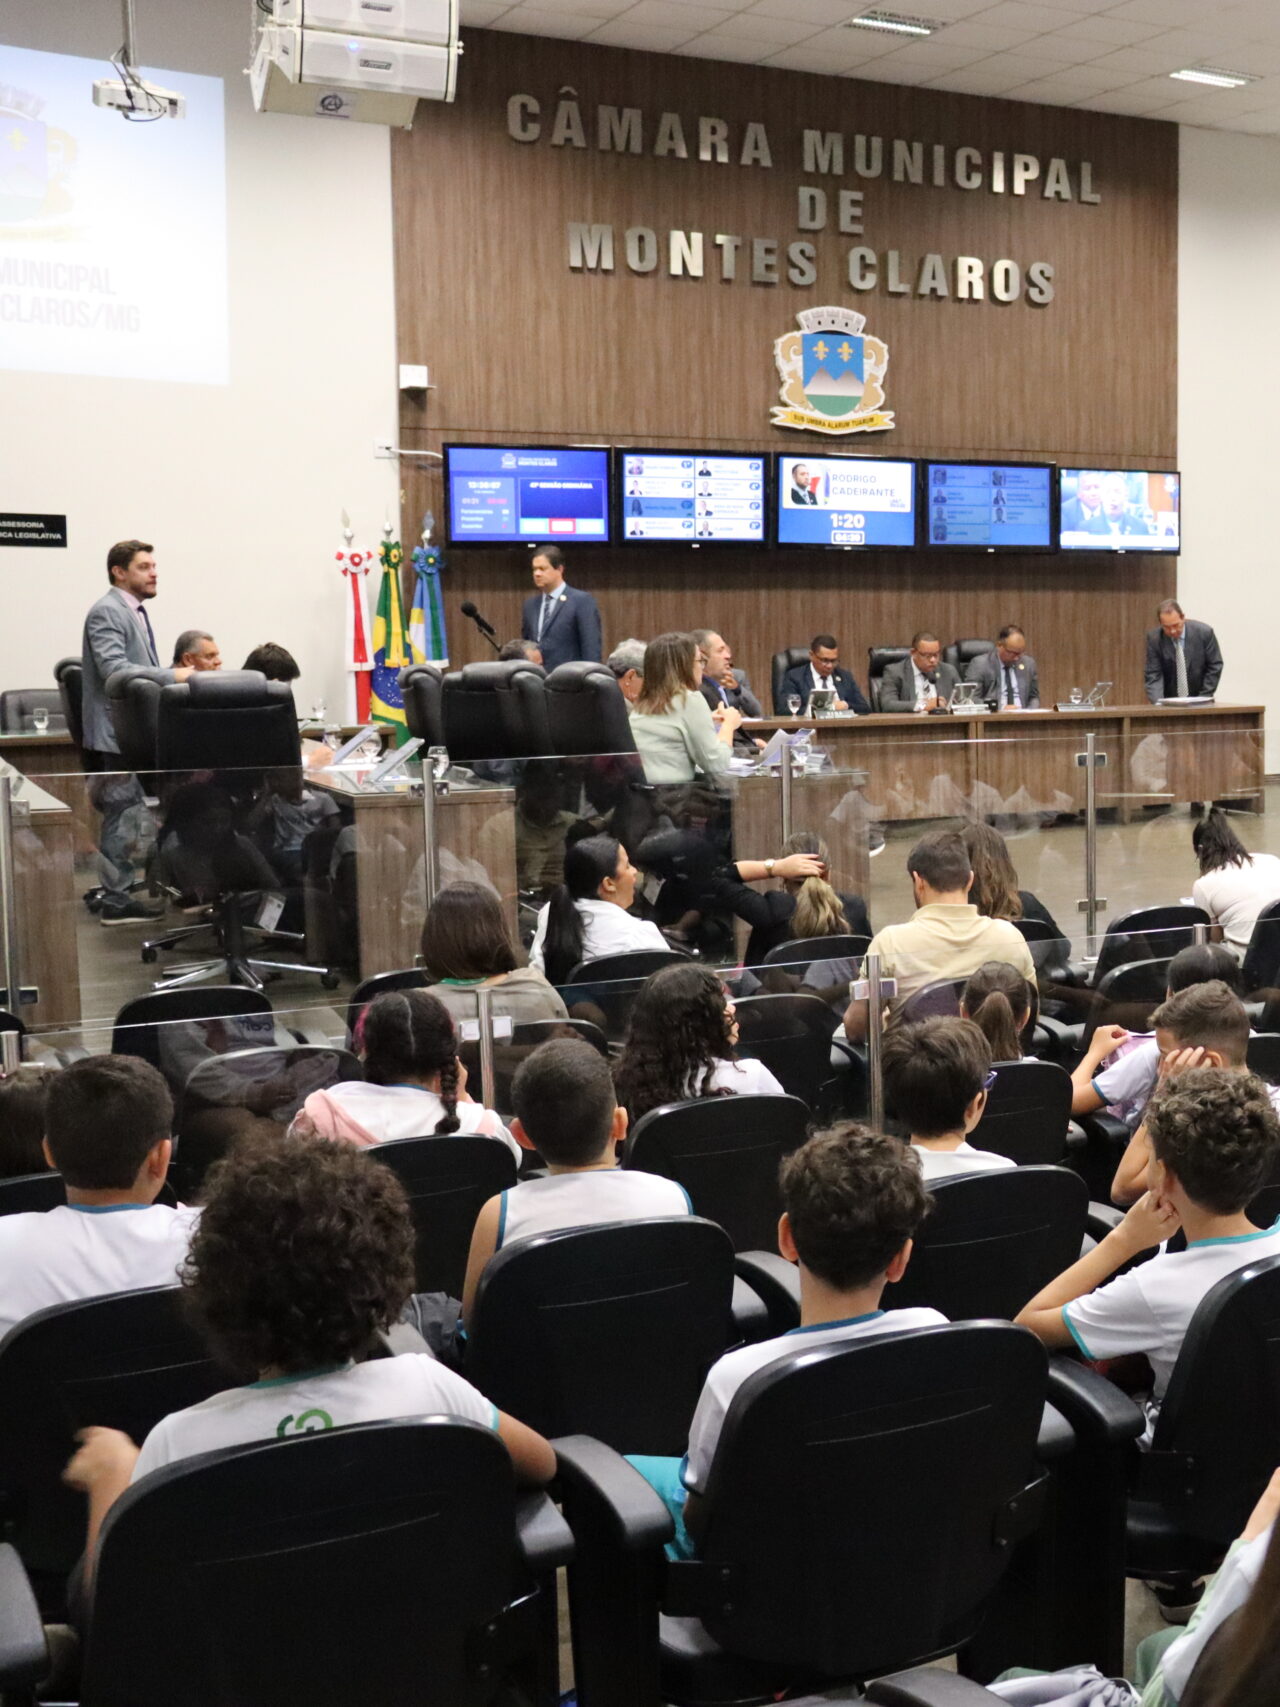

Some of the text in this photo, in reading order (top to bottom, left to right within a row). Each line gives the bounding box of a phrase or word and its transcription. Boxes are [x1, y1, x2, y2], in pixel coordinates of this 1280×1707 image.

[507, 86, 1102, 205] CÂMARA MUNICIPAL
[797, 185, 865, 235] DE
[567, 222, 1055, 305] MONTES CLAROS
[0, 293, 141, 334] CLAROS/MG
[831, 474, 877, 484] RODRIGO
[831, 486, 896, 497] CADEIRANTE
[830, 513, 865, 528] 1:20
[14, 532, 62, 540] LEGISLATIVA
